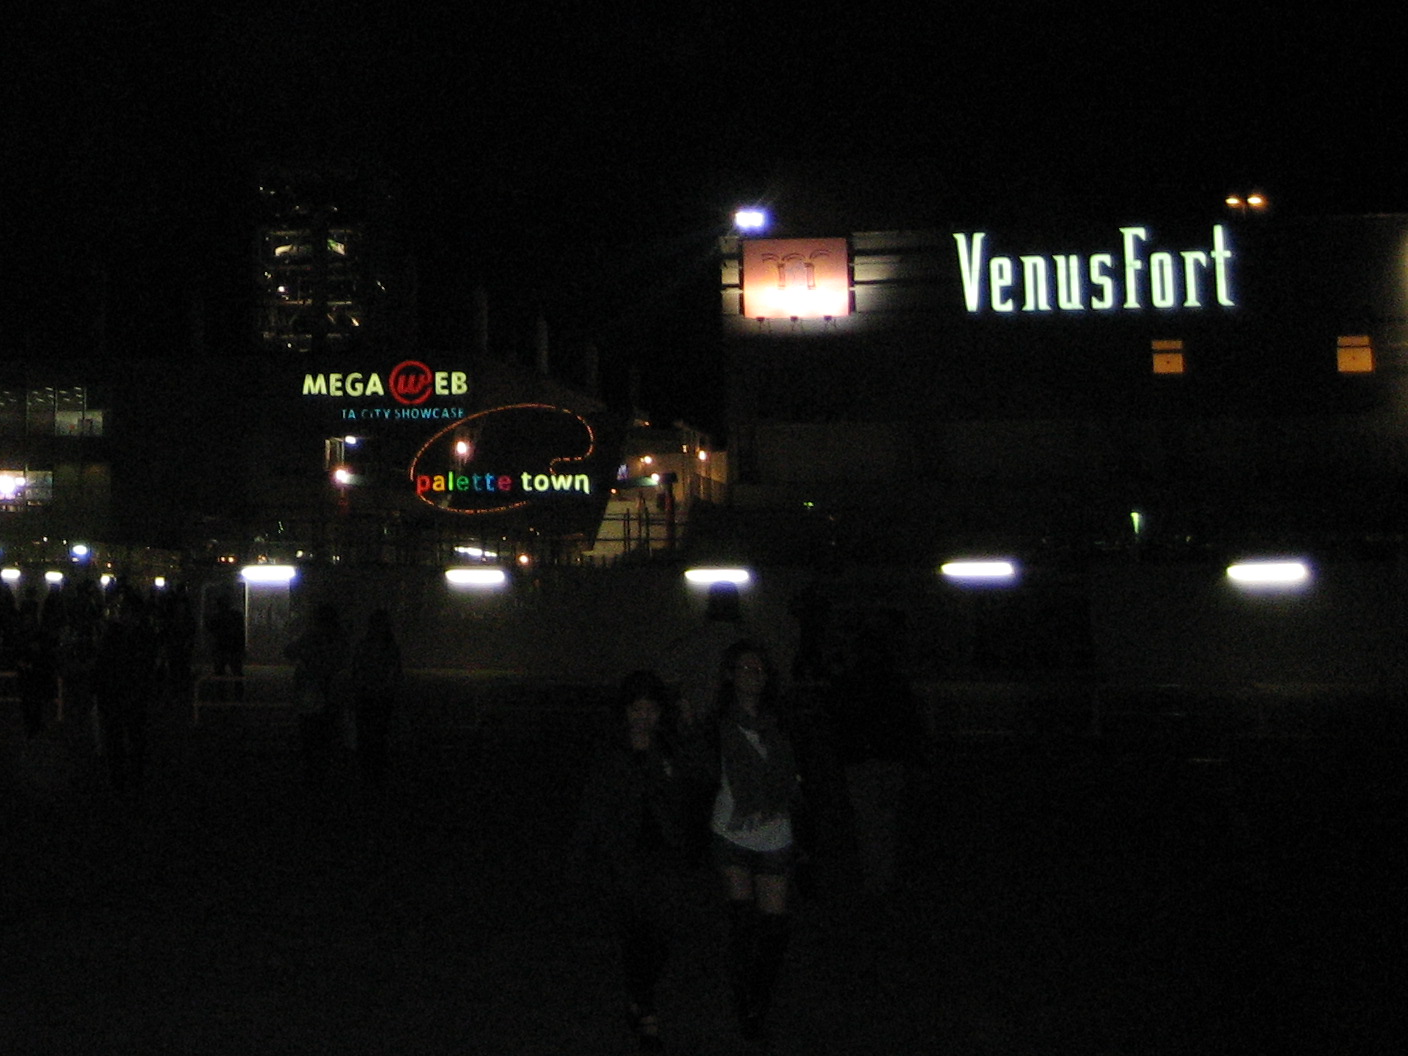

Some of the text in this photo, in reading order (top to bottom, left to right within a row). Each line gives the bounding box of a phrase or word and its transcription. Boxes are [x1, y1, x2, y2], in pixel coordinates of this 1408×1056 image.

[953, 224, 1237, 313] VenusFort
[302, 372, 385, 397] MEGA
[394, 407, 465, 419] SHOWCASE
[416, 470, 591, 495] palette town
